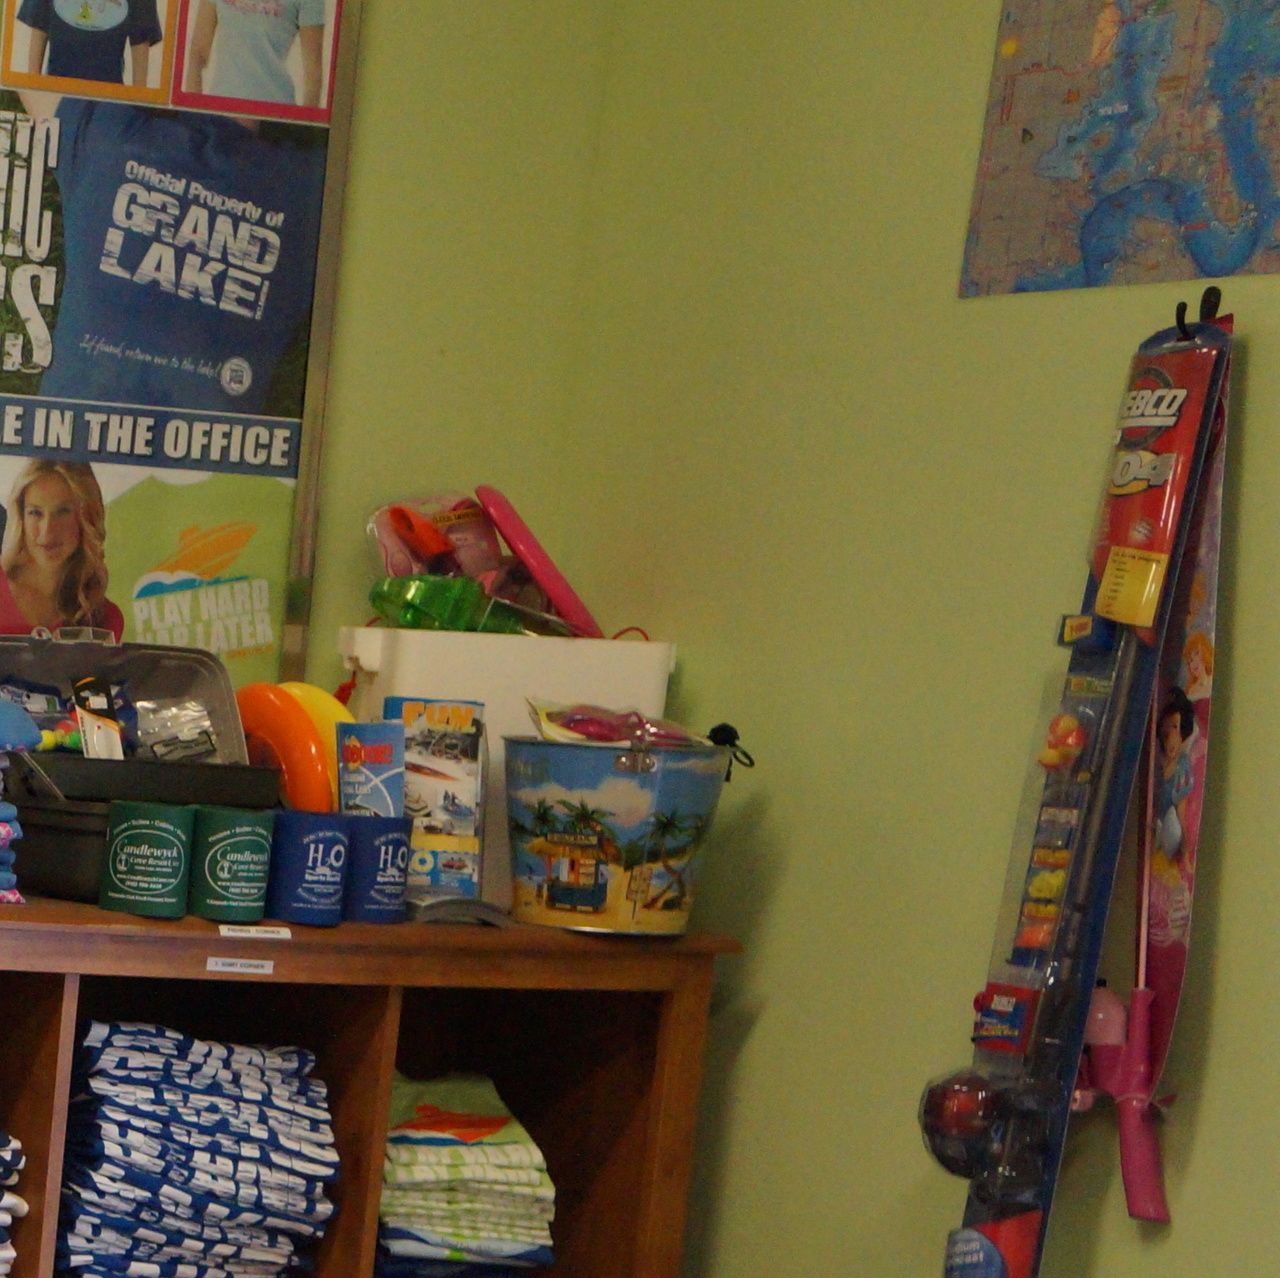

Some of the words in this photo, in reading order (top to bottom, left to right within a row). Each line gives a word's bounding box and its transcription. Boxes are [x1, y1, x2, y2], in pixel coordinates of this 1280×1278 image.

[125, 160, 186, 196] Official
[188, 181, 262, 223] Property
[265, 210, 285, 229] of
[112, 182, 281, 274] GRAND
[1118, 388, 1187, 417] EBCO
[33, 409, 75, 449] IN
[84, 413, 154, 456] THE
[163, 419, 291, 467] OFFICE
[1111, 450, 1178, 487] 04
[133, 588, 191, 637] PLAY
[199, 578, 269, 621] HARD
[402, 701, 477, 732] FUN
